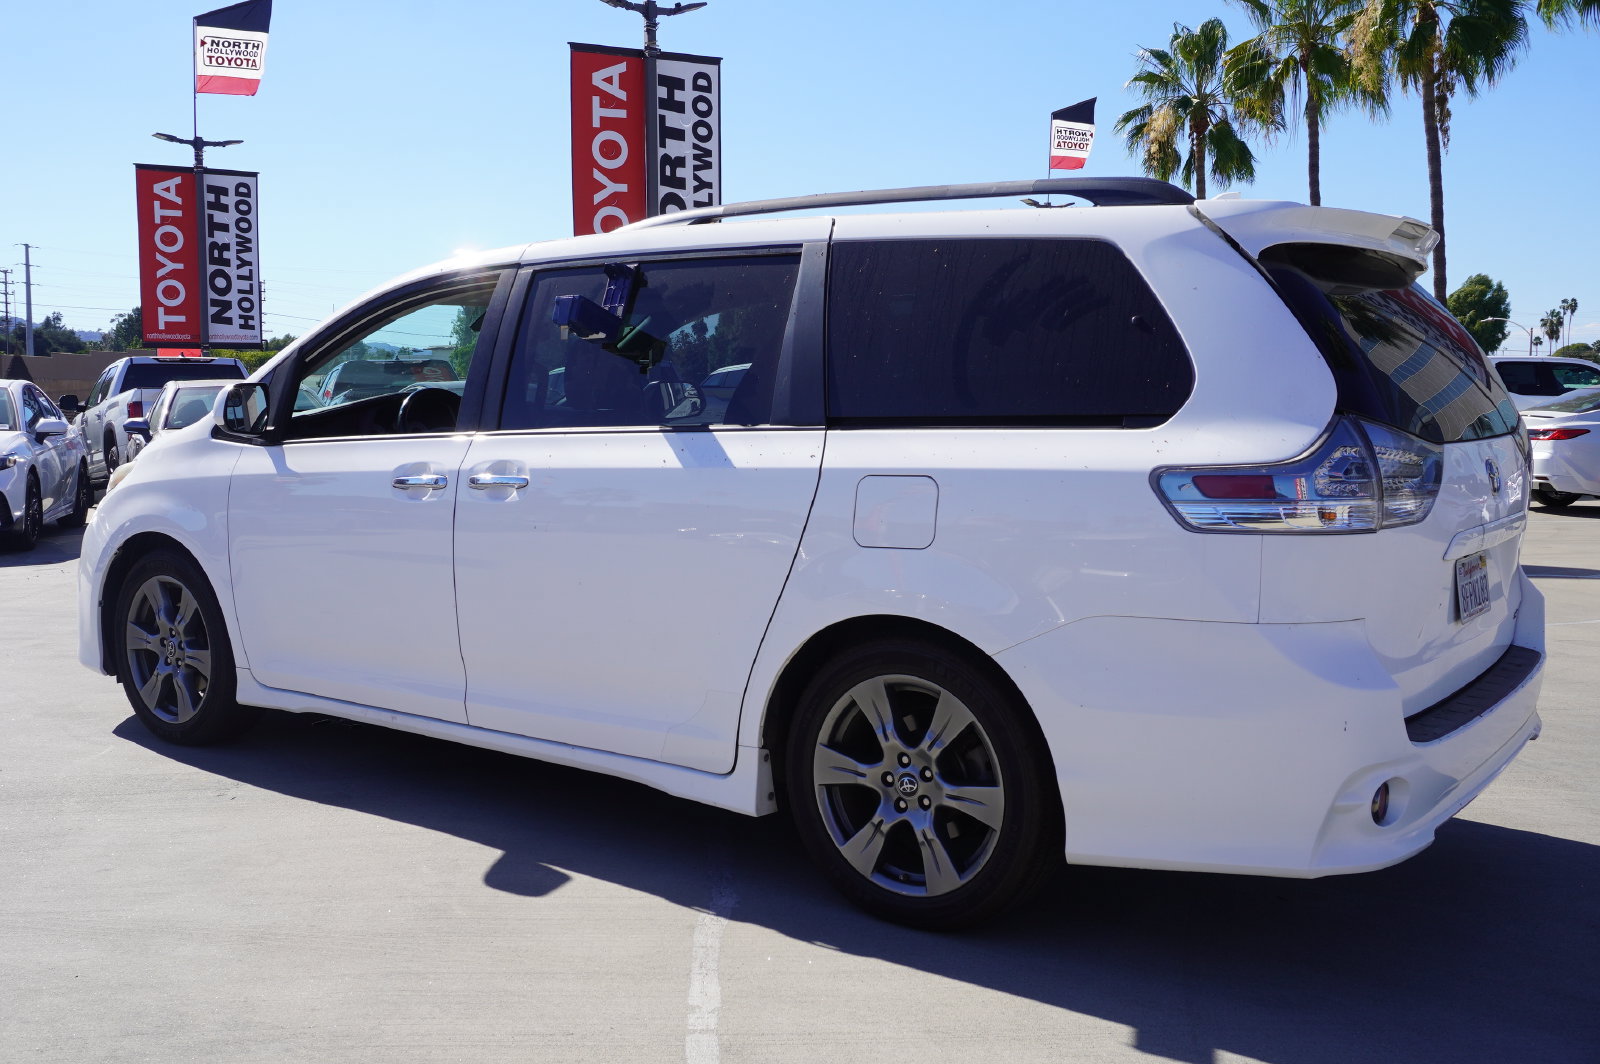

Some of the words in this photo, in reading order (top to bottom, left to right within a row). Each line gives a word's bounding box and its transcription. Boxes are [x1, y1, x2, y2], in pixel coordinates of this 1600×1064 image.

[206, 48, 258, 57] HOLLYWOOD
[206, 55, 257, 68] TOYOTA
[210, 40, 260, 50] NORTH
[591, 61, 630, 234] OYOTA
[657, 73, 687, 215] ORTH
[691, 71, 714, 208] LYWOOD
[152, 175, 186, 330] TOYOTA
[206, 184, 233, 326] NORTH
[234, 181, 256, 331] HOLLYWOOD
